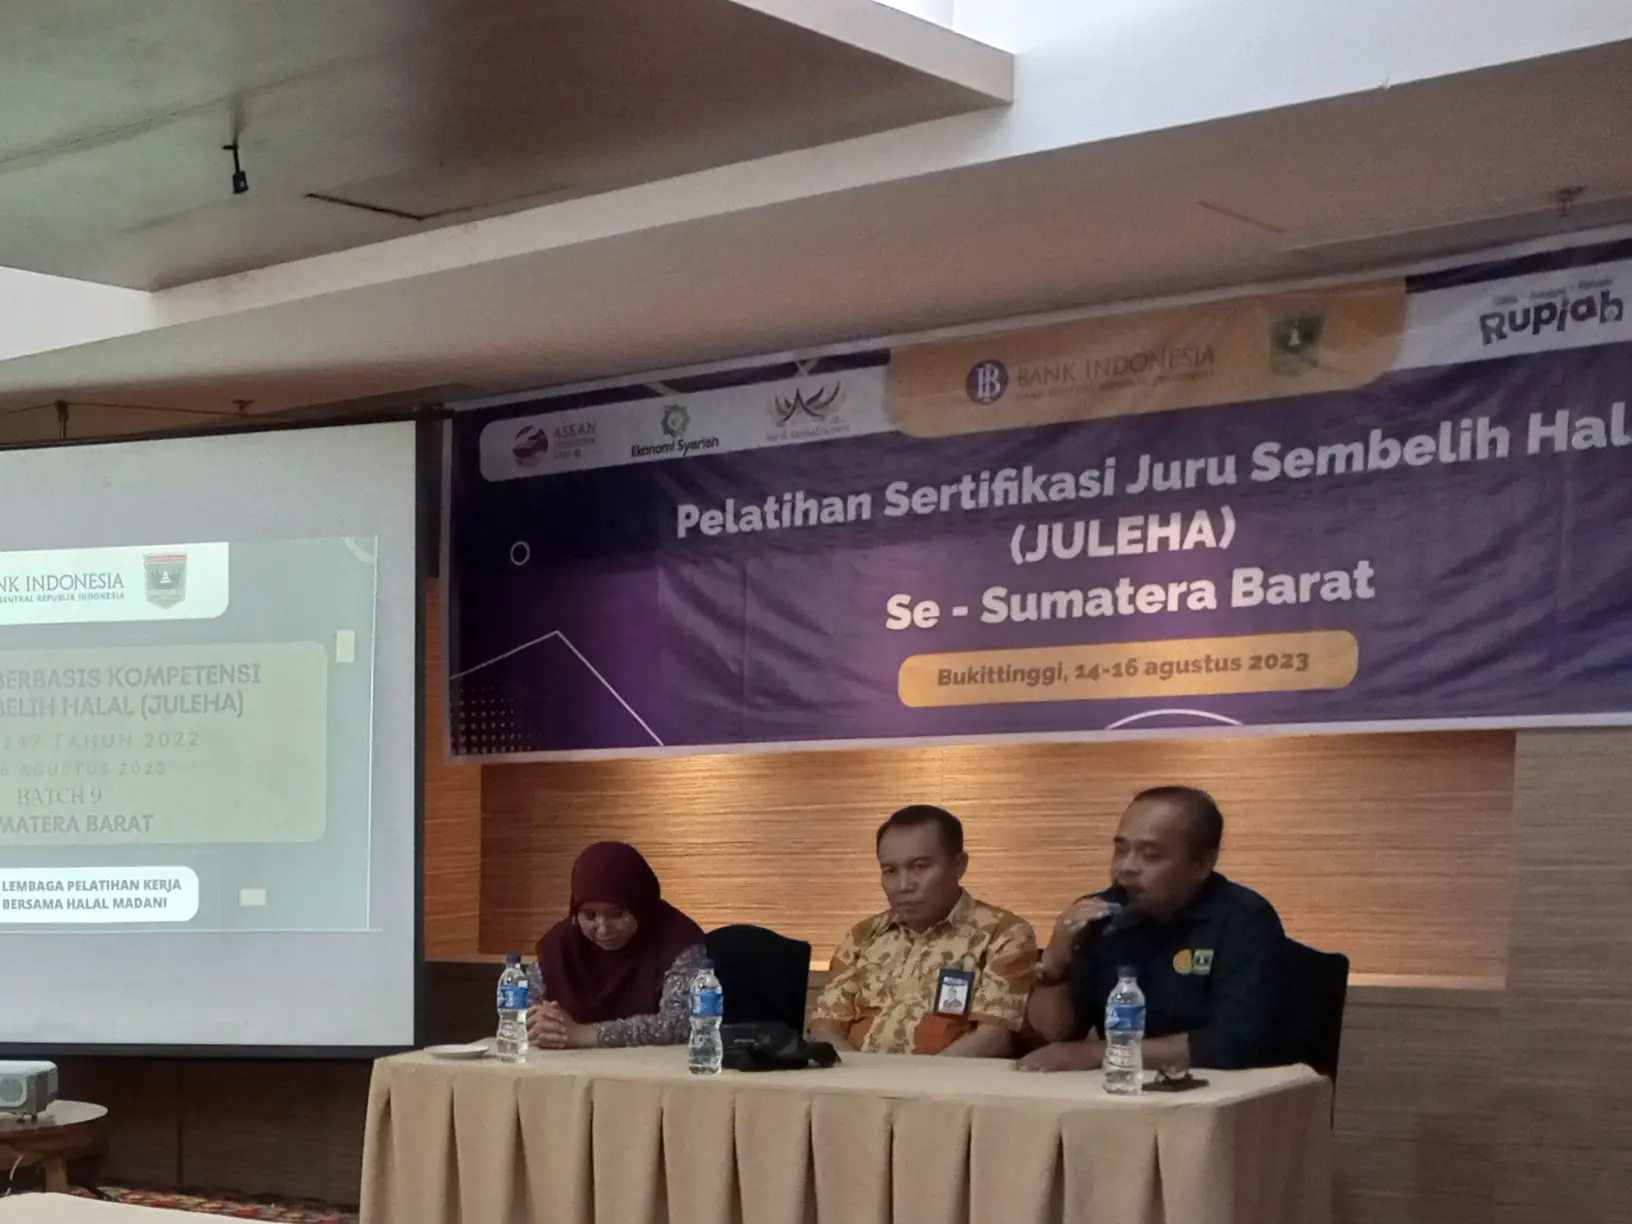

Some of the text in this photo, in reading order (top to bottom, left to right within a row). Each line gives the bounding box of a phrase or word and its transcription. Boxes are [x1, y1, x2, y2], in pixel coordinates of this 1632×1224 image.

[1479, 289, 1624, 345] Rupiah
[1018, 361, 1075, 387] BANK
[1086, 345, 1215, 380] INDONESIA
[631, 436, 719, 457] Ekonomi Syariah
[677, 489, 872, 538] Pelatihan
[884, 457, 1116, 517] Sertifikasi
[1126, 454, 1237, 494] Juru
[1250, 415, 1510, 482] Sembelih
[1011, 506, 1236, 565] (JULEHA)
[26, 572, 125, 591] INDONESIA
[886, 593, 940, 630] Se
[980, 577, 1217, 624] Sumatera
[1231, 560, 1376, 607] Barat
[108, 664, 261, 688] KOMPETENSI
[937, 651, 1310, 688] Bukittinggi, 14-16 agustus 2023
[62, 695, 134, 717] HALAL
[140, 690, 245, 720] (JULEHA)
[53, 733, 132, 750] TAHUN
[144, 731, 200, 749] 2022
[18, 762, 110, 778] AGUSTUS
[17, 787, 103, 806] BATCH 9
[86, 813, 154, 833] BARAT
[2, 879, 182, 893] LEMBAGA PELATIHAN KERJA
[2, 897, 168, 910] BERSAMA HALAL MADANI
